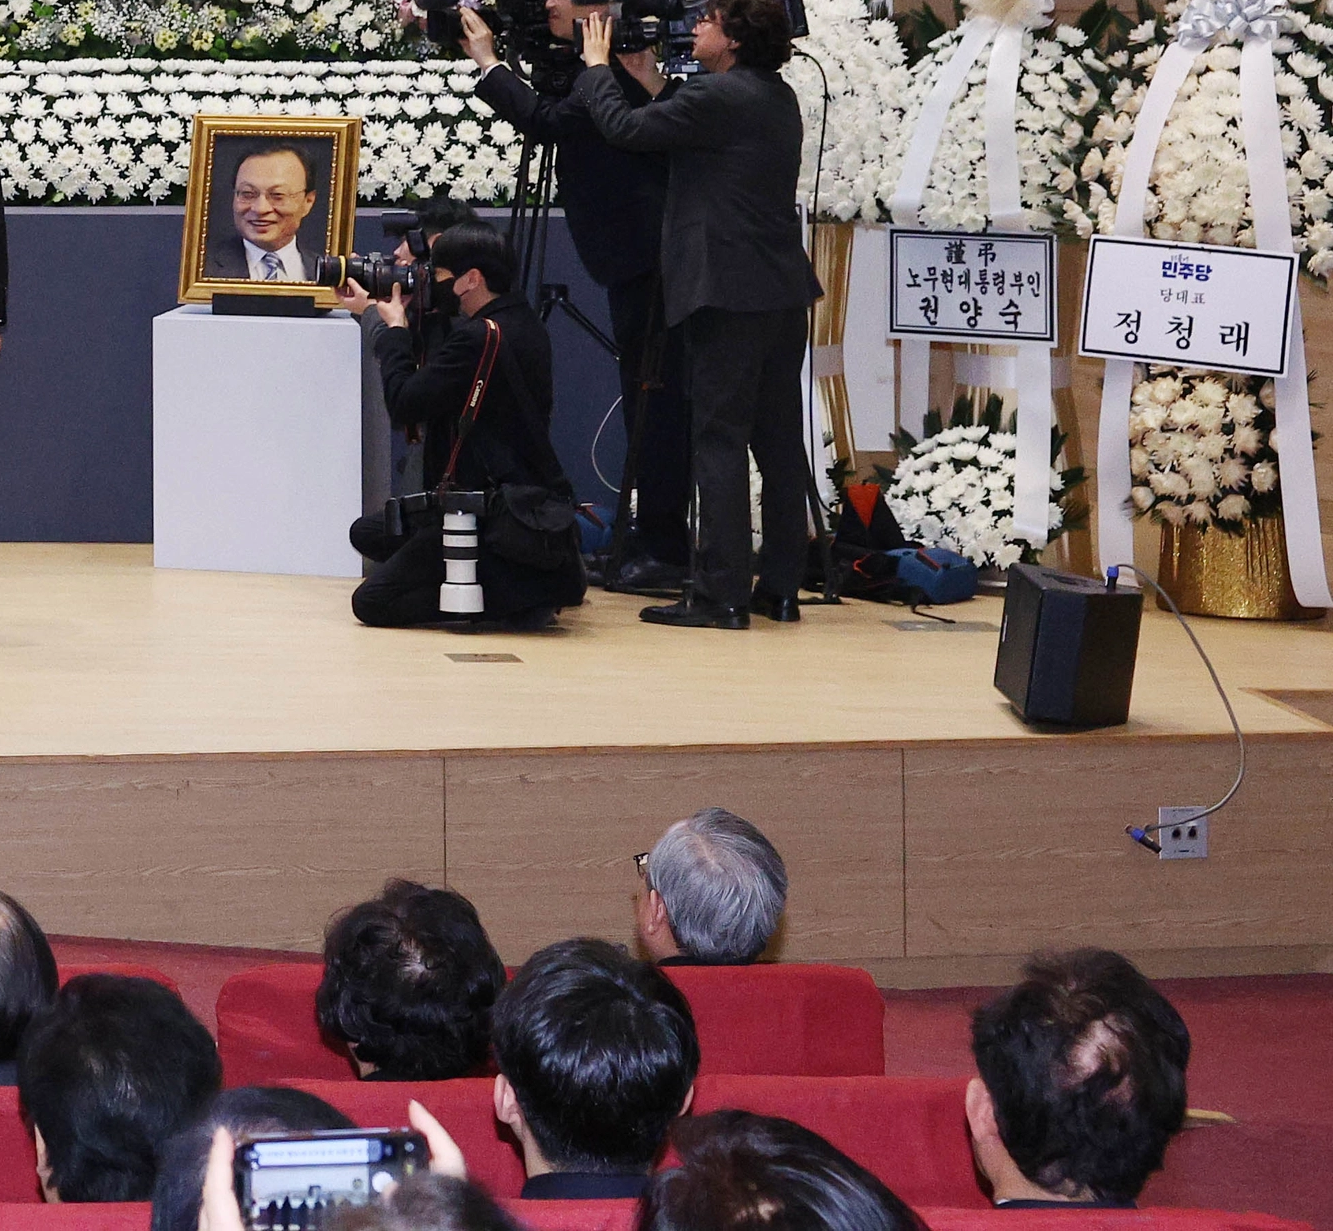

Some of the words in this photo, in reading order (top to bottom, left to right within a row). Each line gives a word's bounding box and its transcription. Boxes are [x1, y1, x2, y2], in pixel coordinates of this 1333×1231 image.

[1162, 261, 1213, 281] 민주당
[1160, 288, 1205, 305] 당대표
[470, 380, 484, 407] Canon
